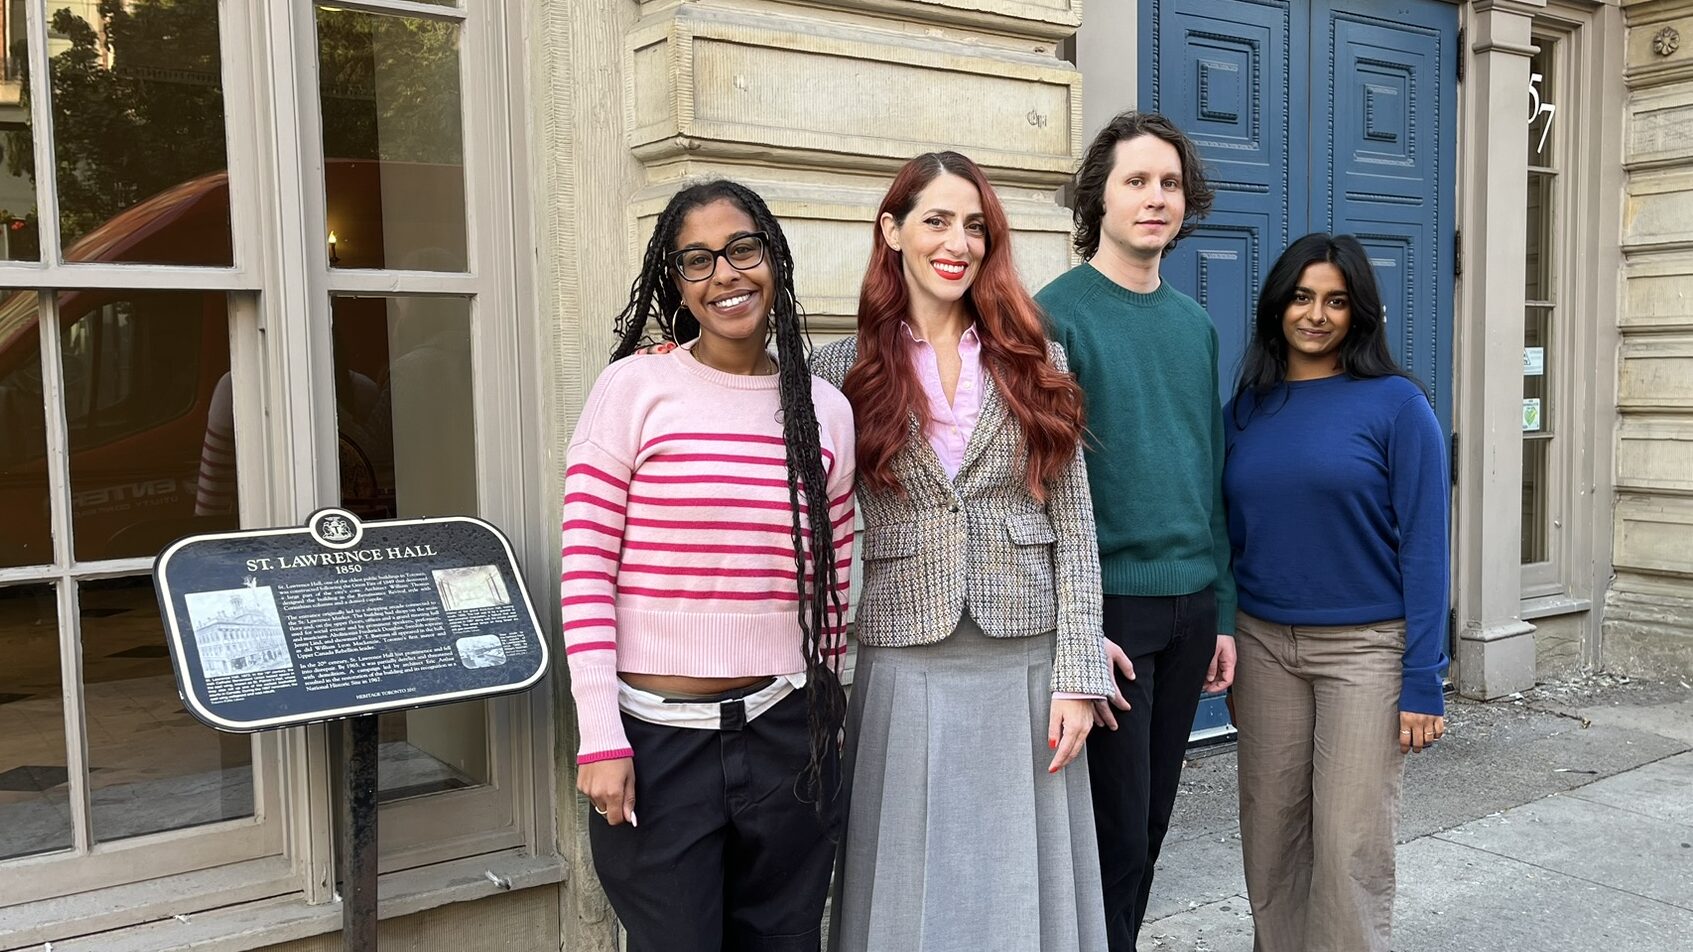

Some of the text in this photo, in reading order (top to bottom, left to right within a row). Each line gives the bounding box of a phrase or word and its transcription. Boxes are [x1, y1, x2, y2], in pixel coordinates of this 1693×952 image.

[246, 544, 437, 572] ST. LAWRENCE HALL
[336, 564, 362, 574] 1850
